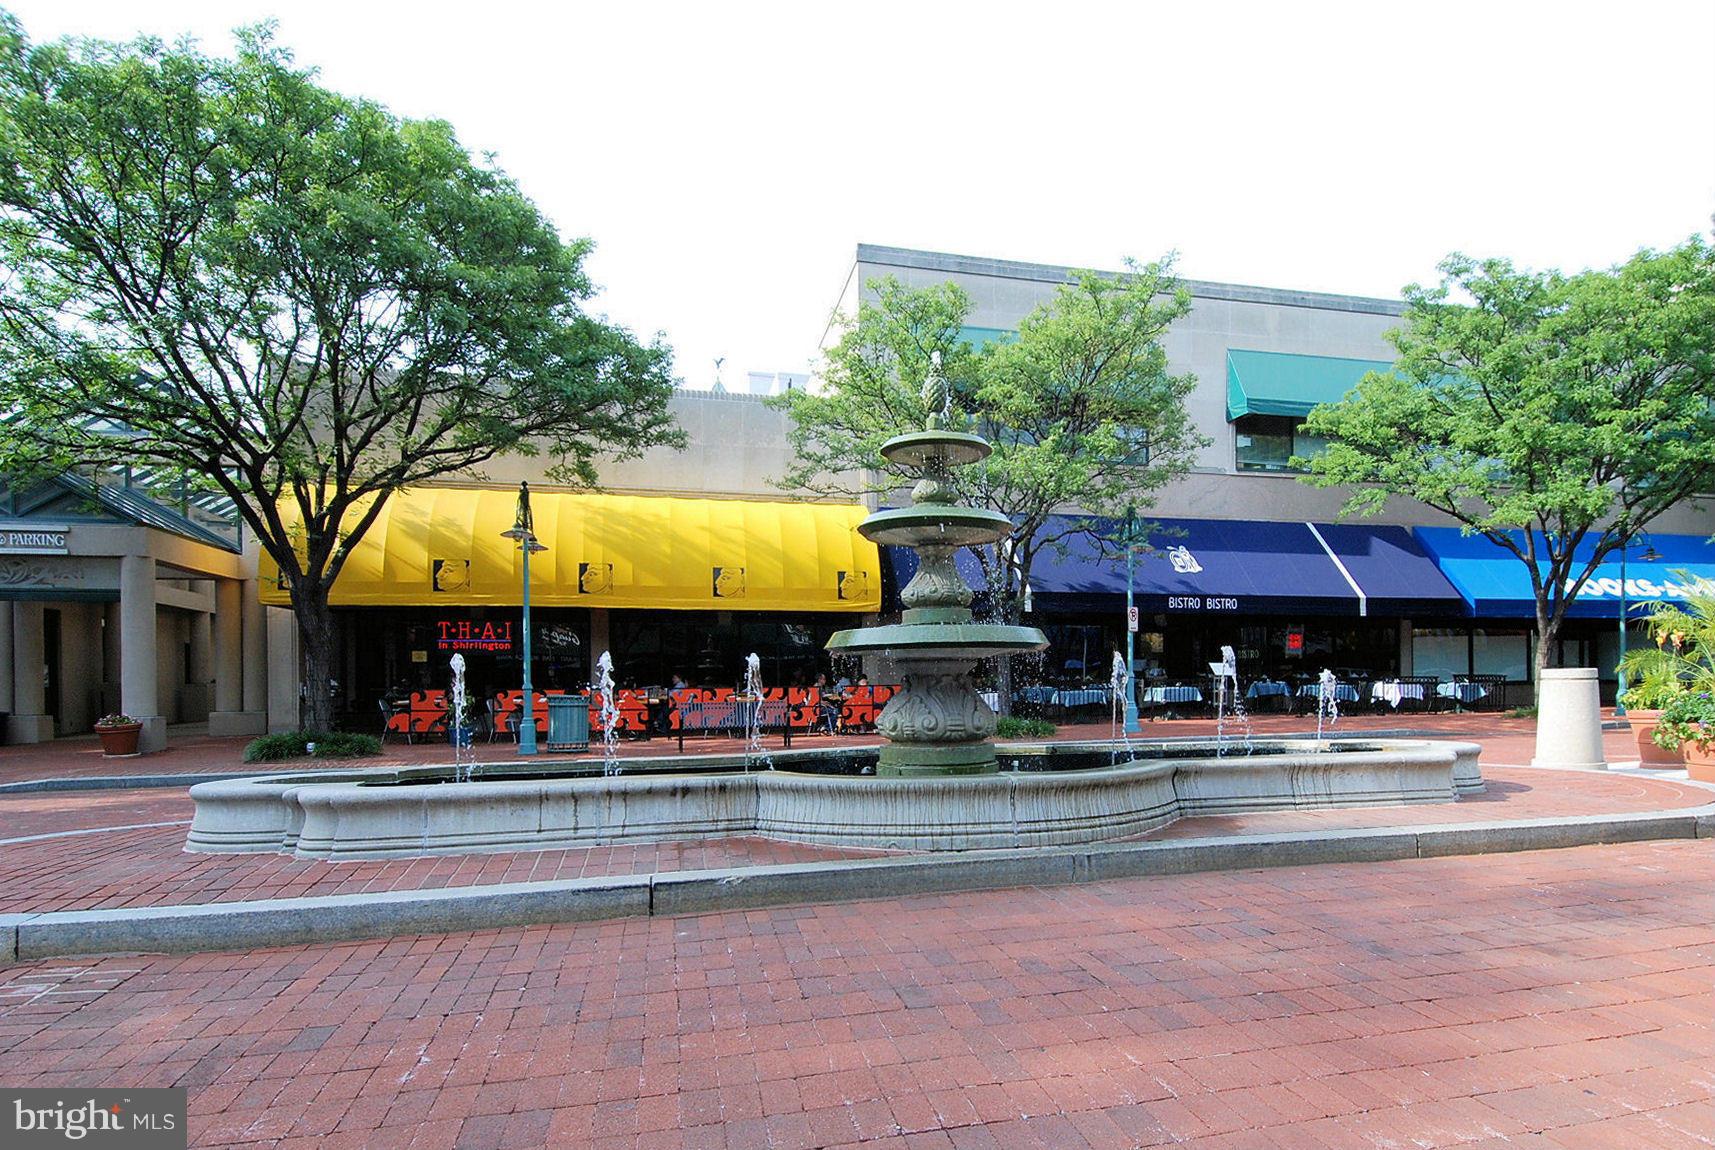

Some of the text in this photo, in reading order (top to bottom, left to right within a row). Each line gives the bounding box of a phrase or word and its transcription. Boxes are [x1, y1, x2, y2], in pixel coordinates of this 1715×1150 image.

[10, 533, 65, 546] PARKING
[1168, 597, 1238, 610] BISTRO BISTRO
[452, 640, 511, 651] Shirlington
